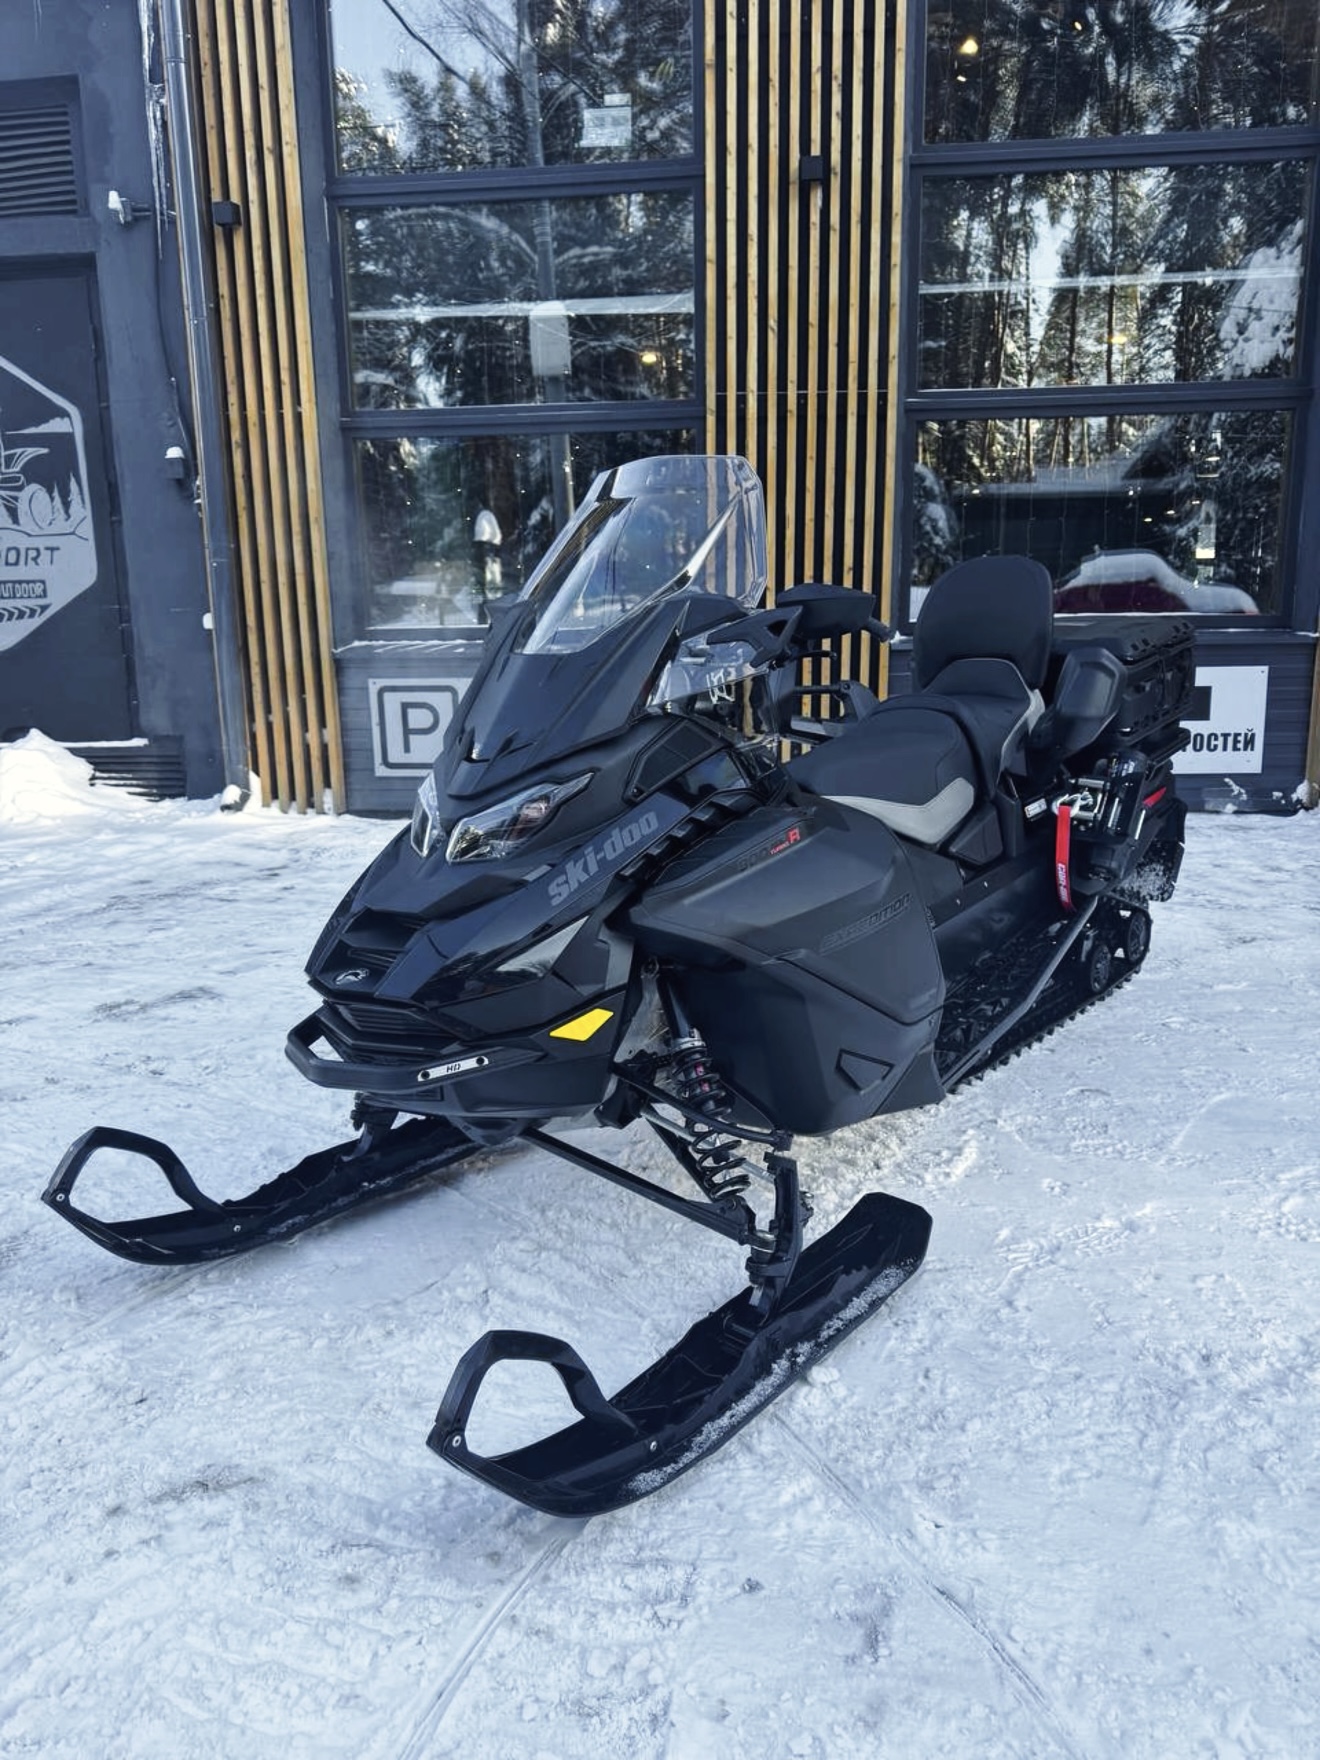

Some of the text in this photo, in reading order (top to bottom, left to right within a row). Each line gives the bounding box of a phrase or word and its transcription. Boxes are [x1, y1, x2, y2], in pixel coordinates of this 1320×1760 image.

[0, 546, 61, 567] ORT
[0, 582, 45, 598] UTDOOR
[400, 701, 440, 754] P
[1181, 728, 1256, 753] ОСТЕЙ
